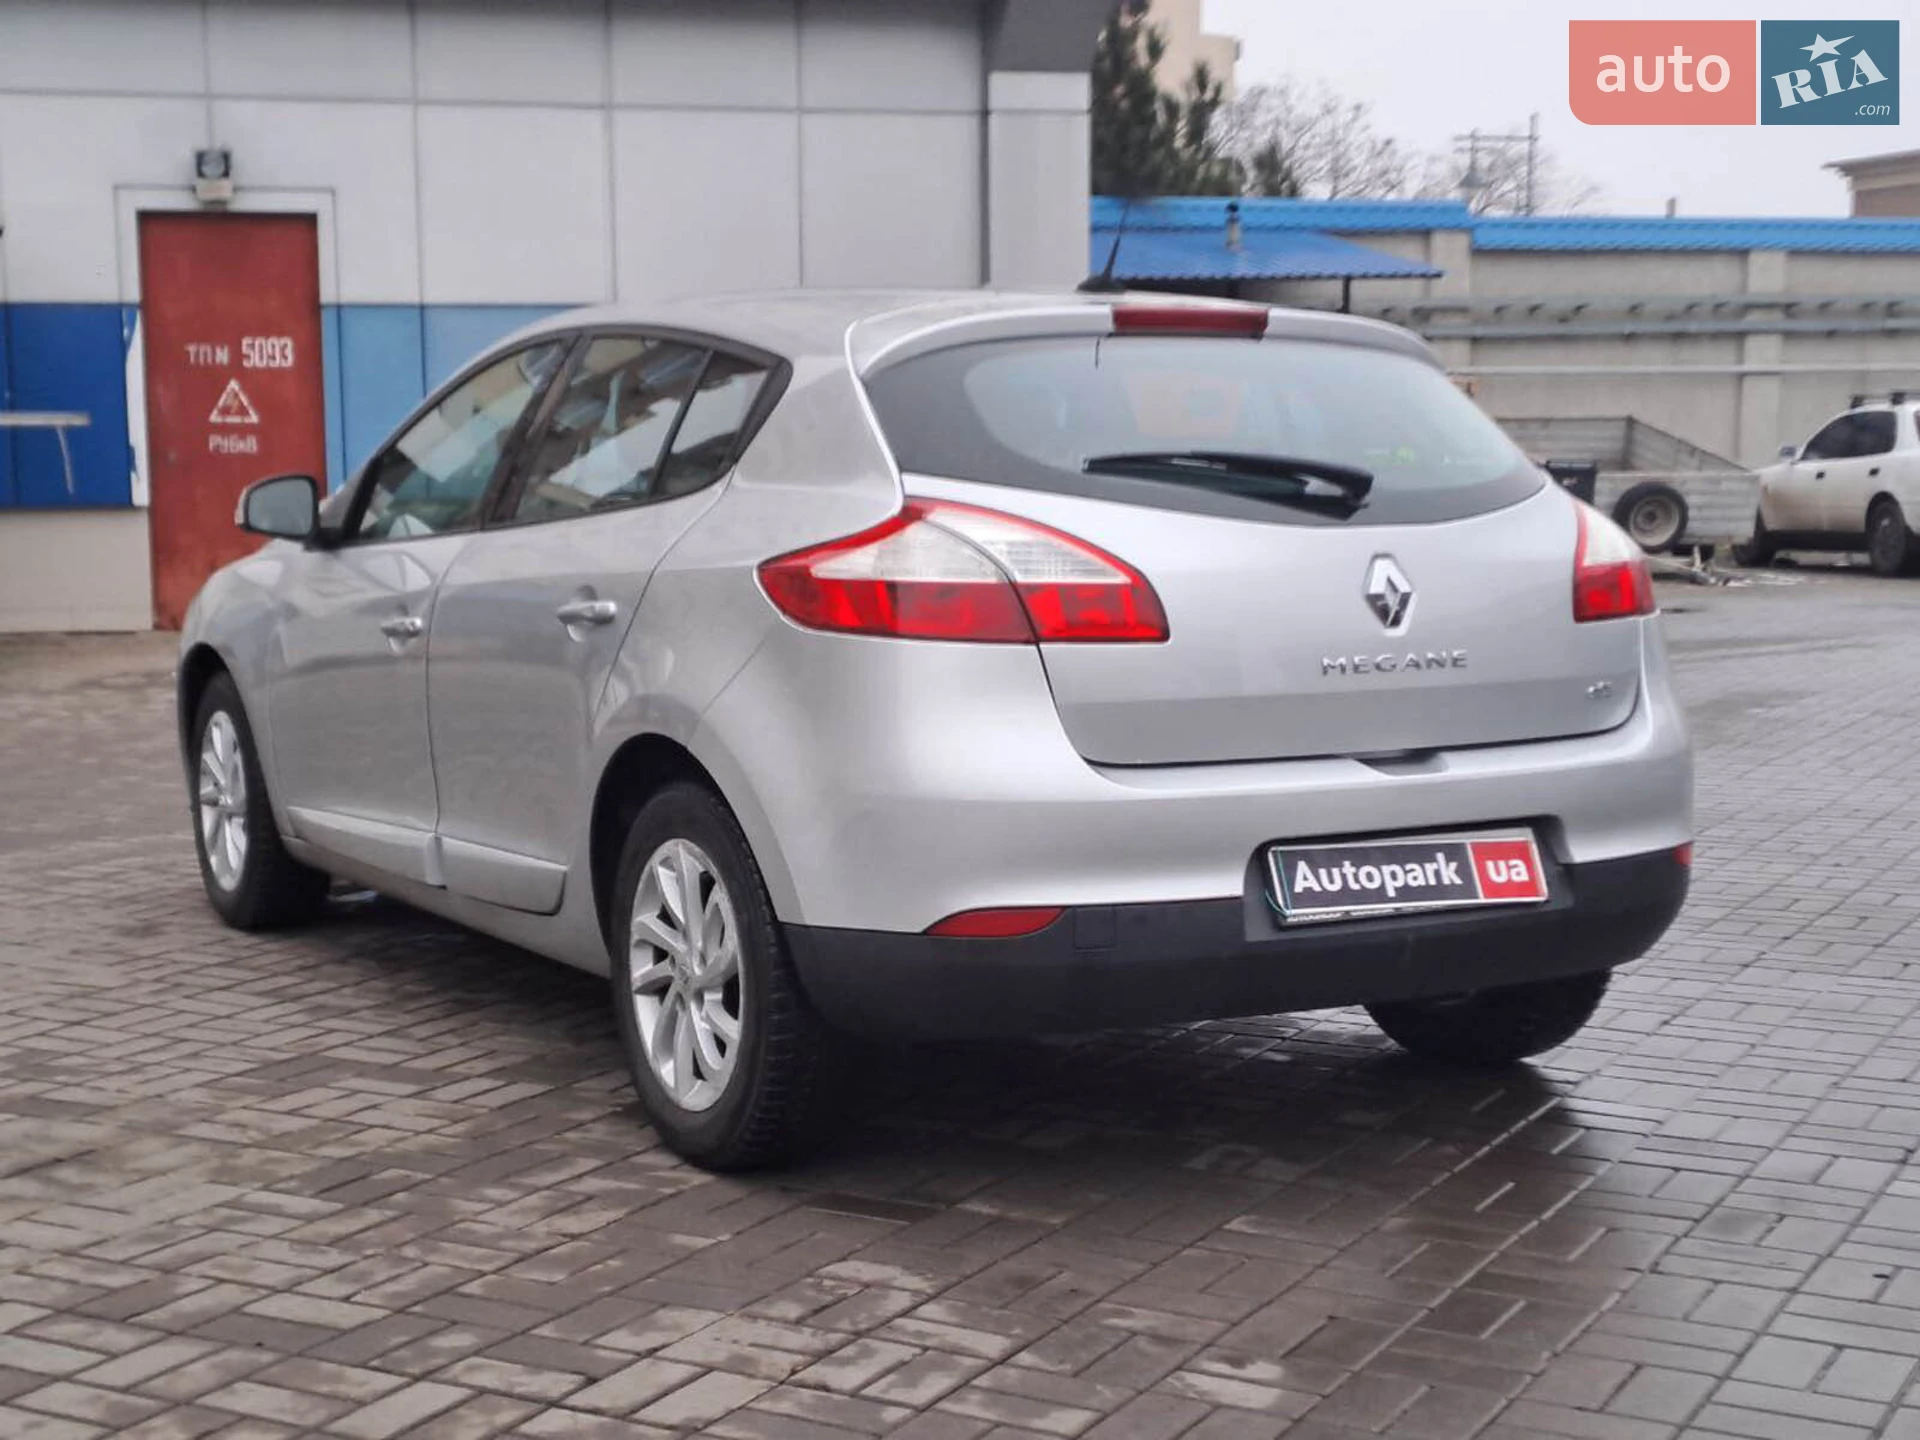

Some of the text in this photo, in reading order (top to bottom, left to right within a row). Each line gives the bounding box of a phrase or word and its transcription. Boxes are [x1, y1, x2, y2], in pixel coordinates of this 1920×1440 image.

[241, 336, 294, 369] 5093
[1320, 649, 1469, 676] MEGANE
[1293, 852, 1531, 898] Autopark ua
